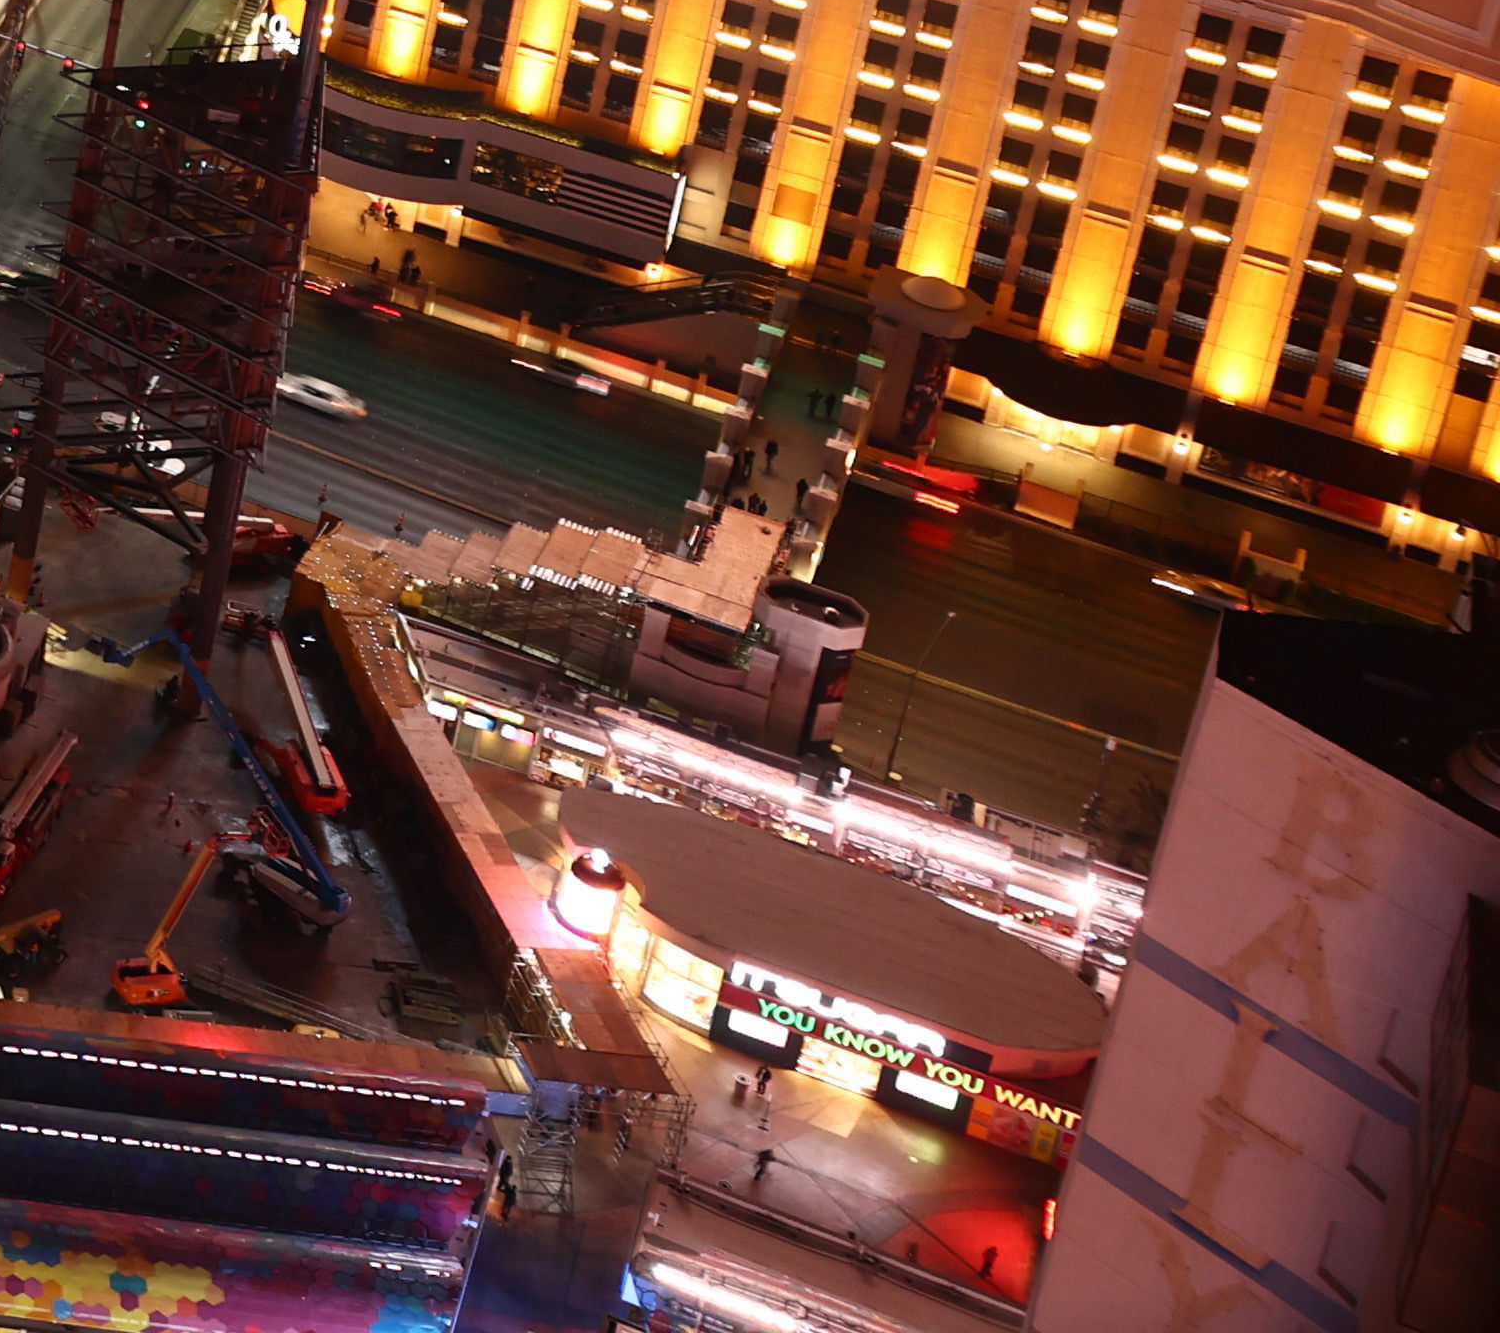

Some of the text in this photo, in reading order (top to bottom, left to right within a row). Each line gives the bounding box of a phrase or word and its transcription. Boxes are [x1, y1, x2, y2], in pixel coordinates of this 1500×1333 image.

[757, 998, 1083, 1130] YOU KNOW YOU WANT
